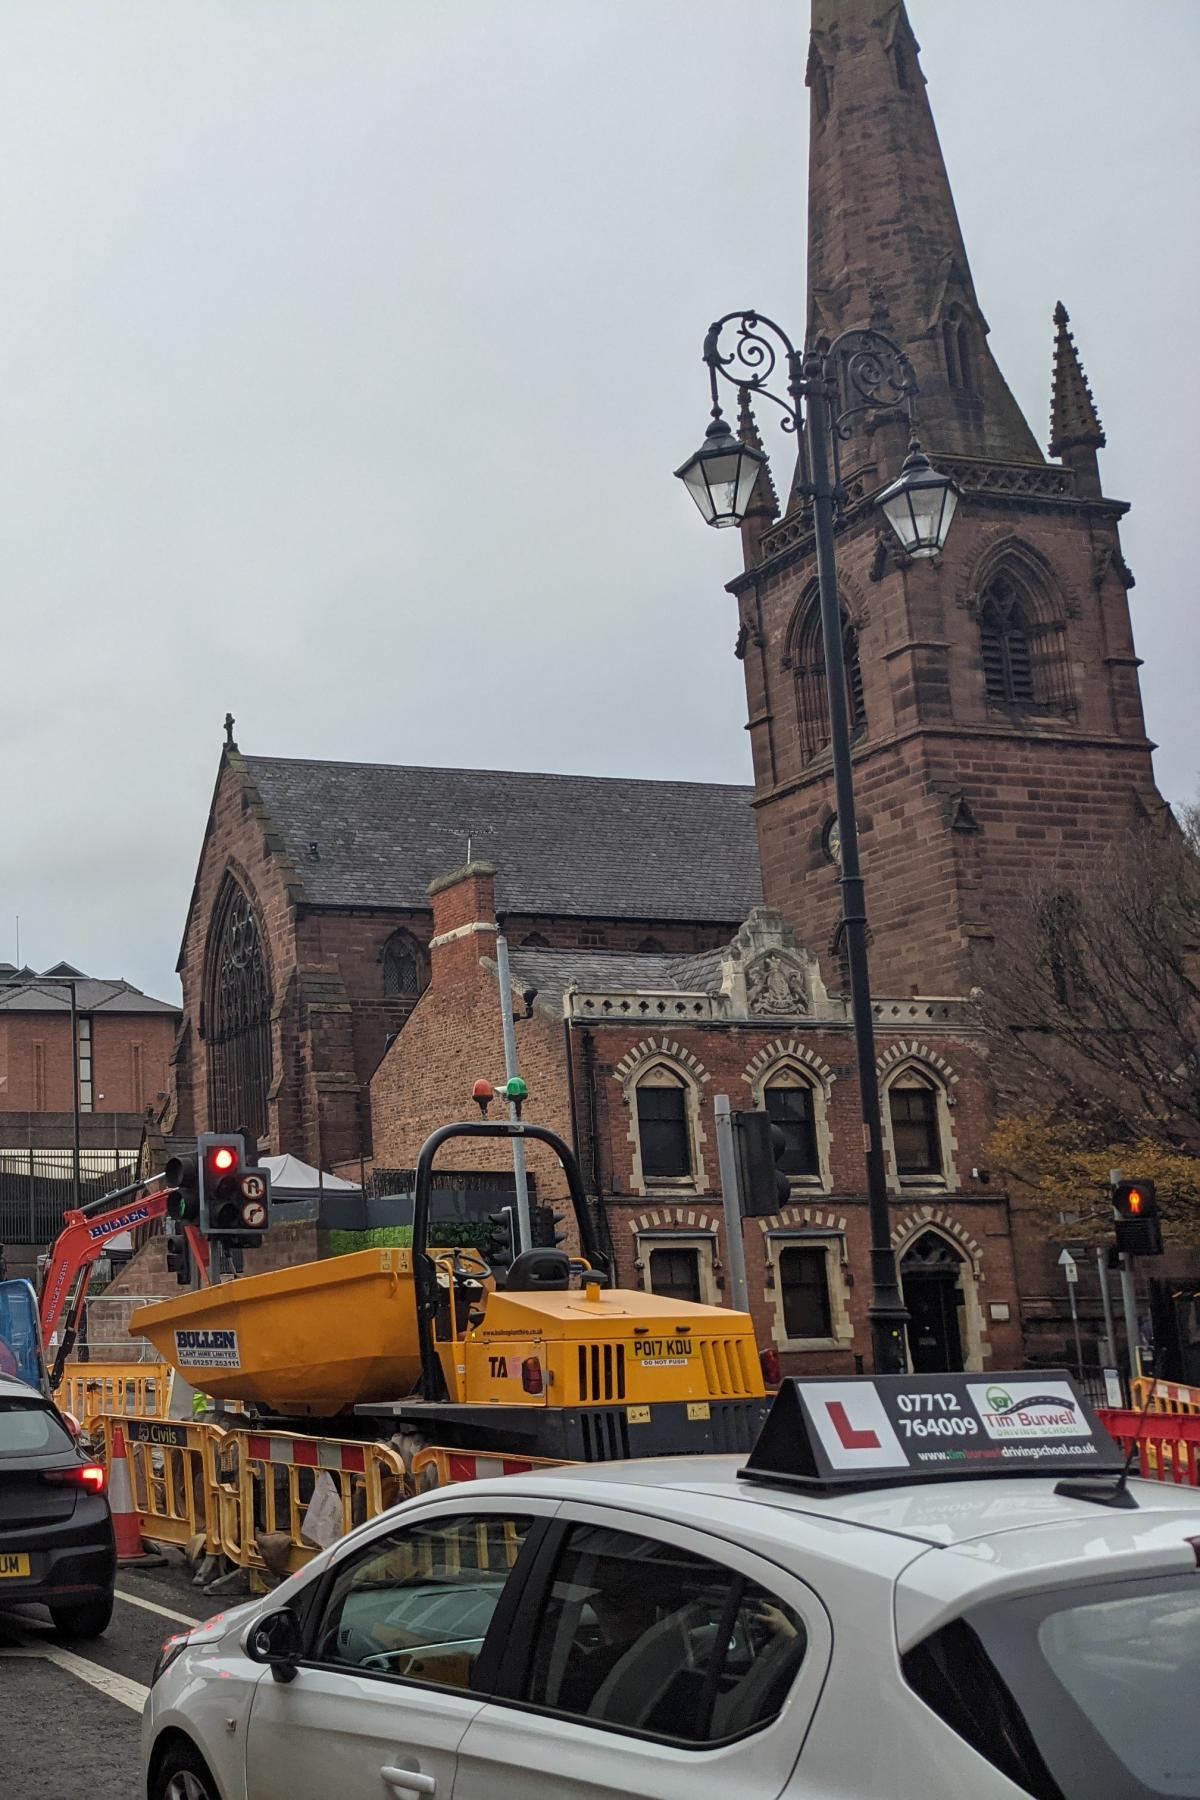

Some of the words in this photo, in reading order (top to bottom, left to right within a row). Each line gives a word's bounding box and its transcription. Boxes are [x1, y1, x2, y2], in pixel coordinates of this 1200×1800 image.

[89, 1207, 149, 1240] BULLEN
[176, 1331, 235, 1349] BULLEN
[634, 1341, 662, 1356] PO17
[666, 1340, 692, 1355] KDU
[897, 1393, 961, 1412] 07712
[824, 1401, 882, 1450] L
[899, 1417, 978, 1437] 764009
[982, 1413, 1015, 1428] Tim
[1017, 1411, 1077, 1427] Burwell
[151, 1424, 177, 1444] Civils
[997, 1428, 1038, 1437] DRIVING
[1040, 1427, 1079, 1435] SCHOOL
